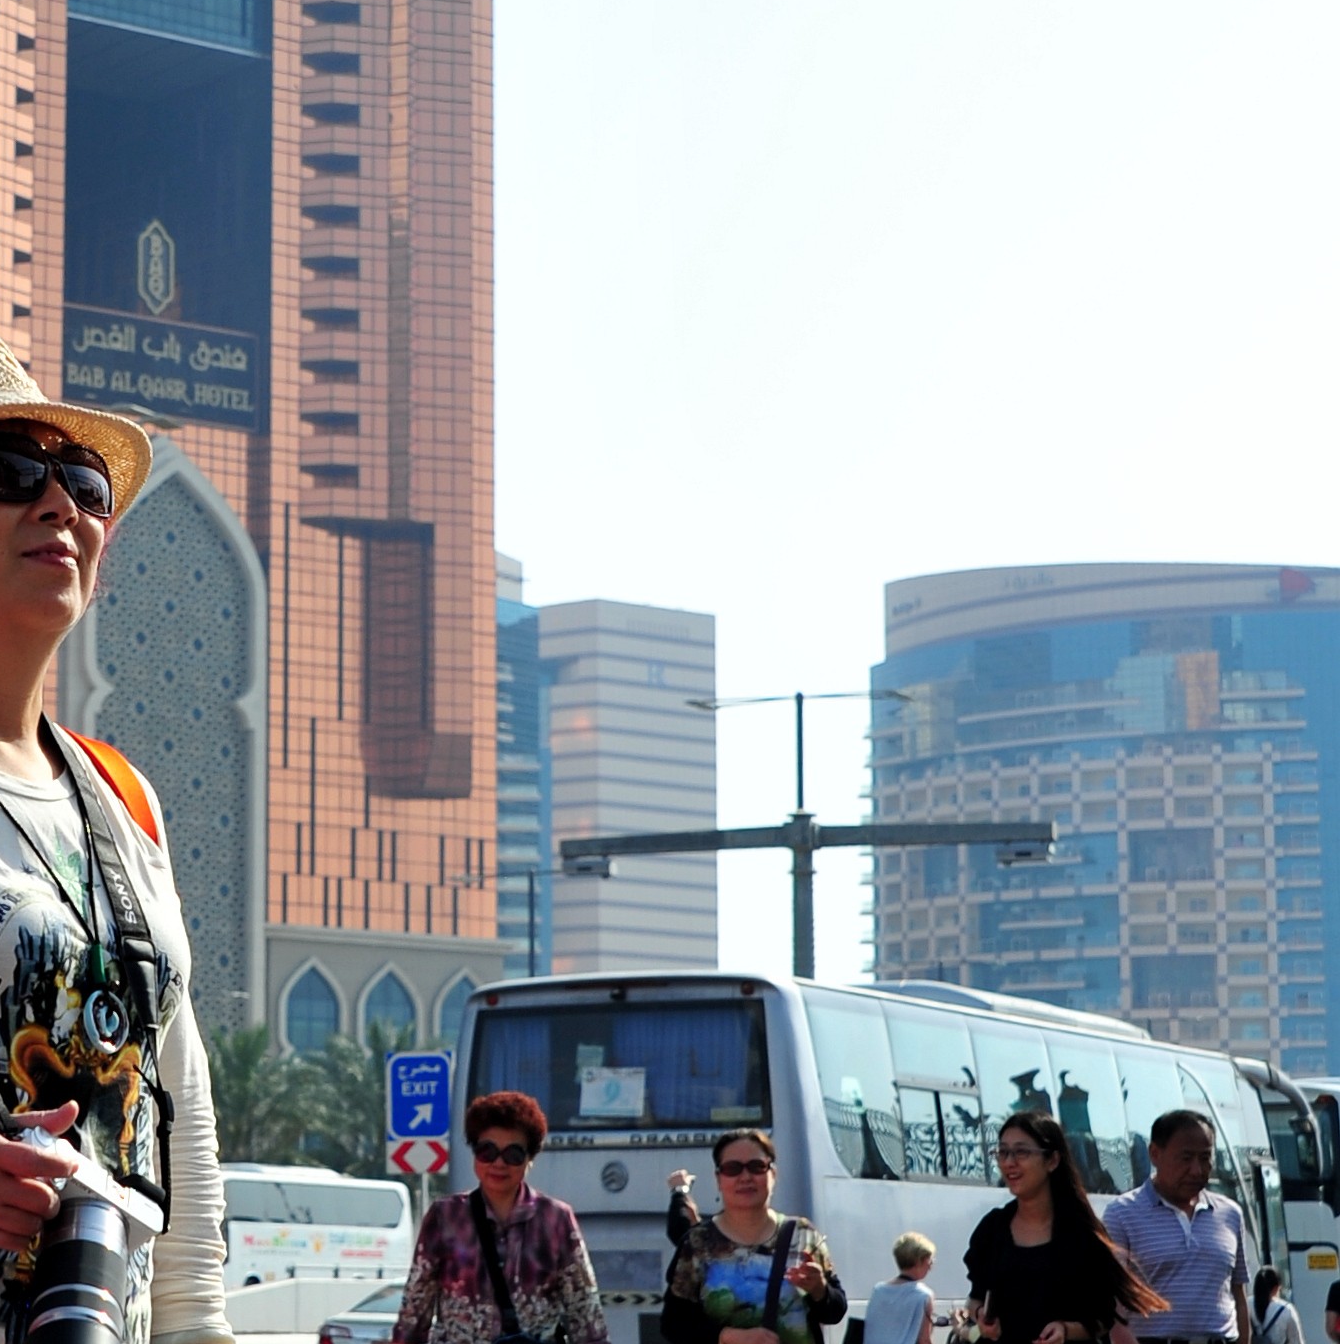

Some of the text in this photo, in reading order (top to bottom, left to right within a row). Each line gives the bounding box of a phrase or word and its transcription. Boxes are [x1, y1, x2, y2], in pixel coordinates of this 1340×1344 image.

[72, 324, 247, 371] فندق باب القصر
[67, 362, 254, 412] BAB AL QASR HOTEL
[110, 867, 137, 924] SONY
[401, 1081, 438, 1096] EXIT
